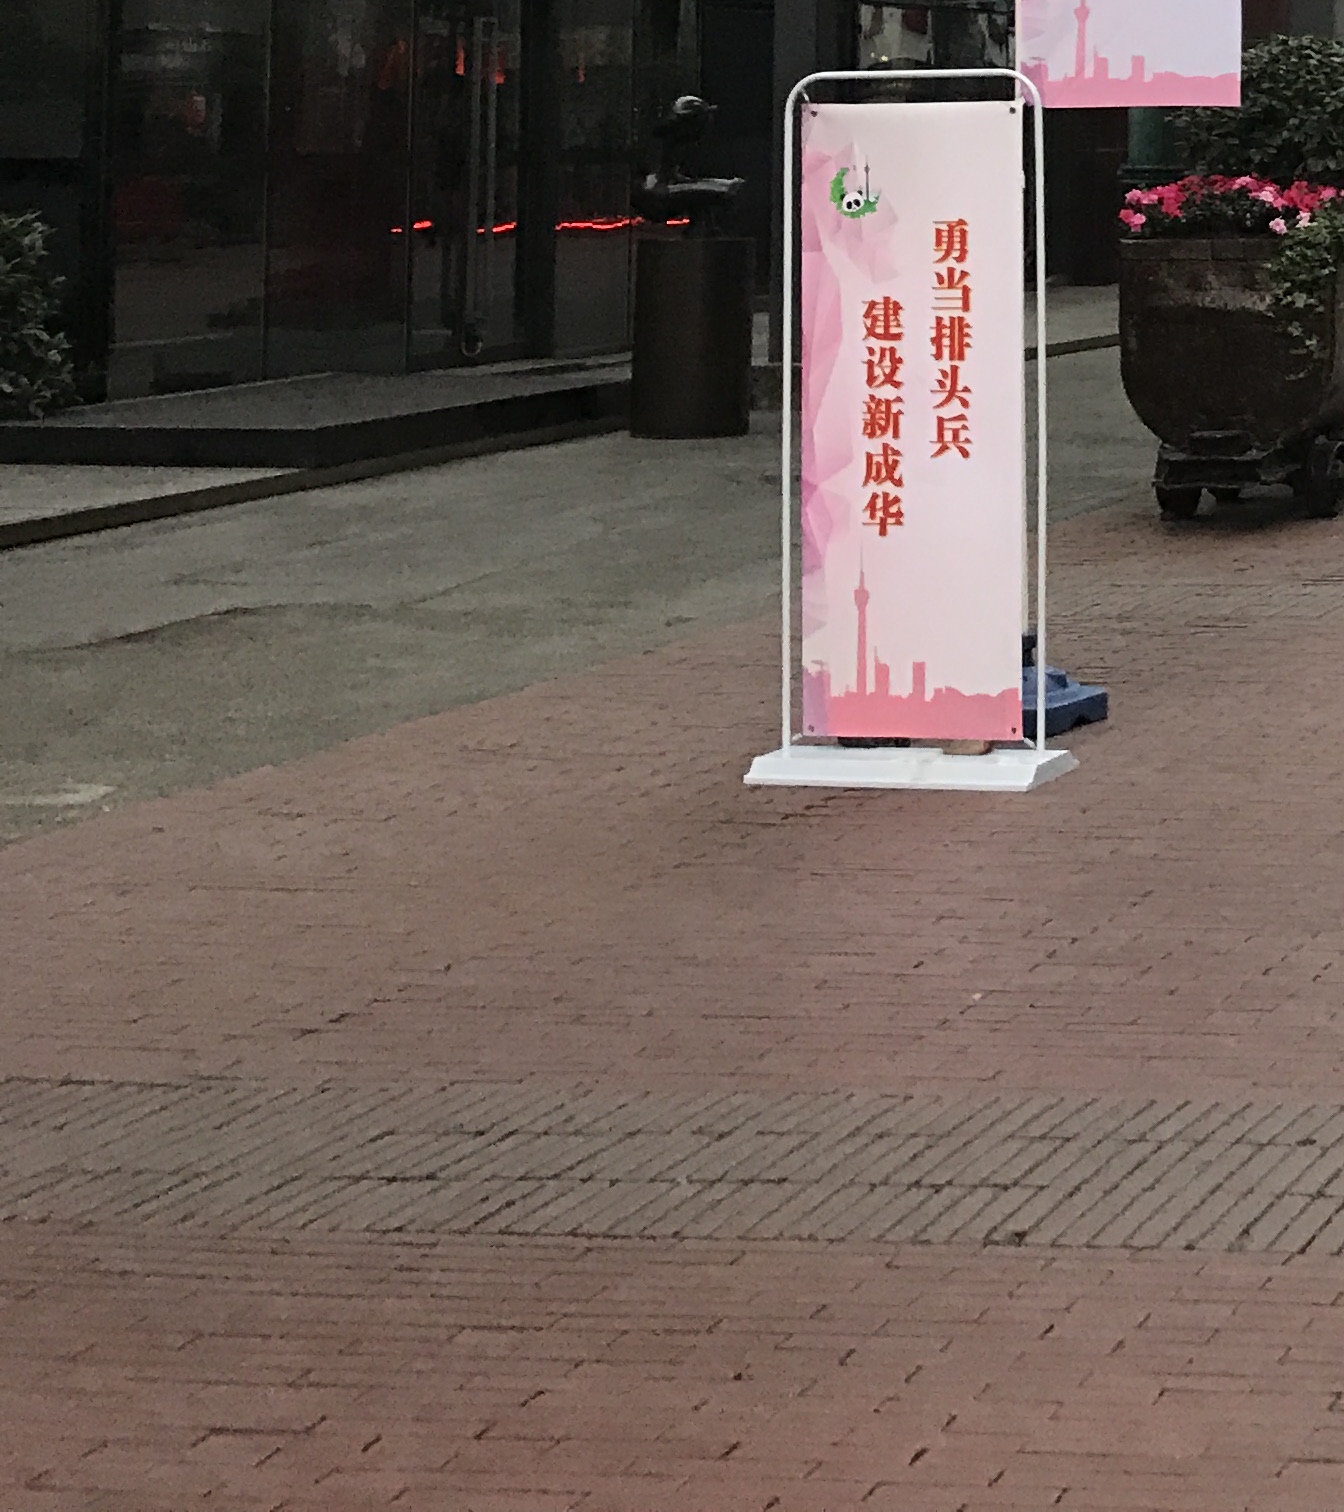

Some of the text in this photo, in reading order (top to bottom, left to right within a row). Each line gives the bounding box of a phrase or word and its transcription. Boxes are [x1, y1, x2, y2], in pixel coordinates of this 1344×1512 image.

[860, 294, 905, 538] 建设新成华
[929, 217, 974, 461] 勇当排头兵
